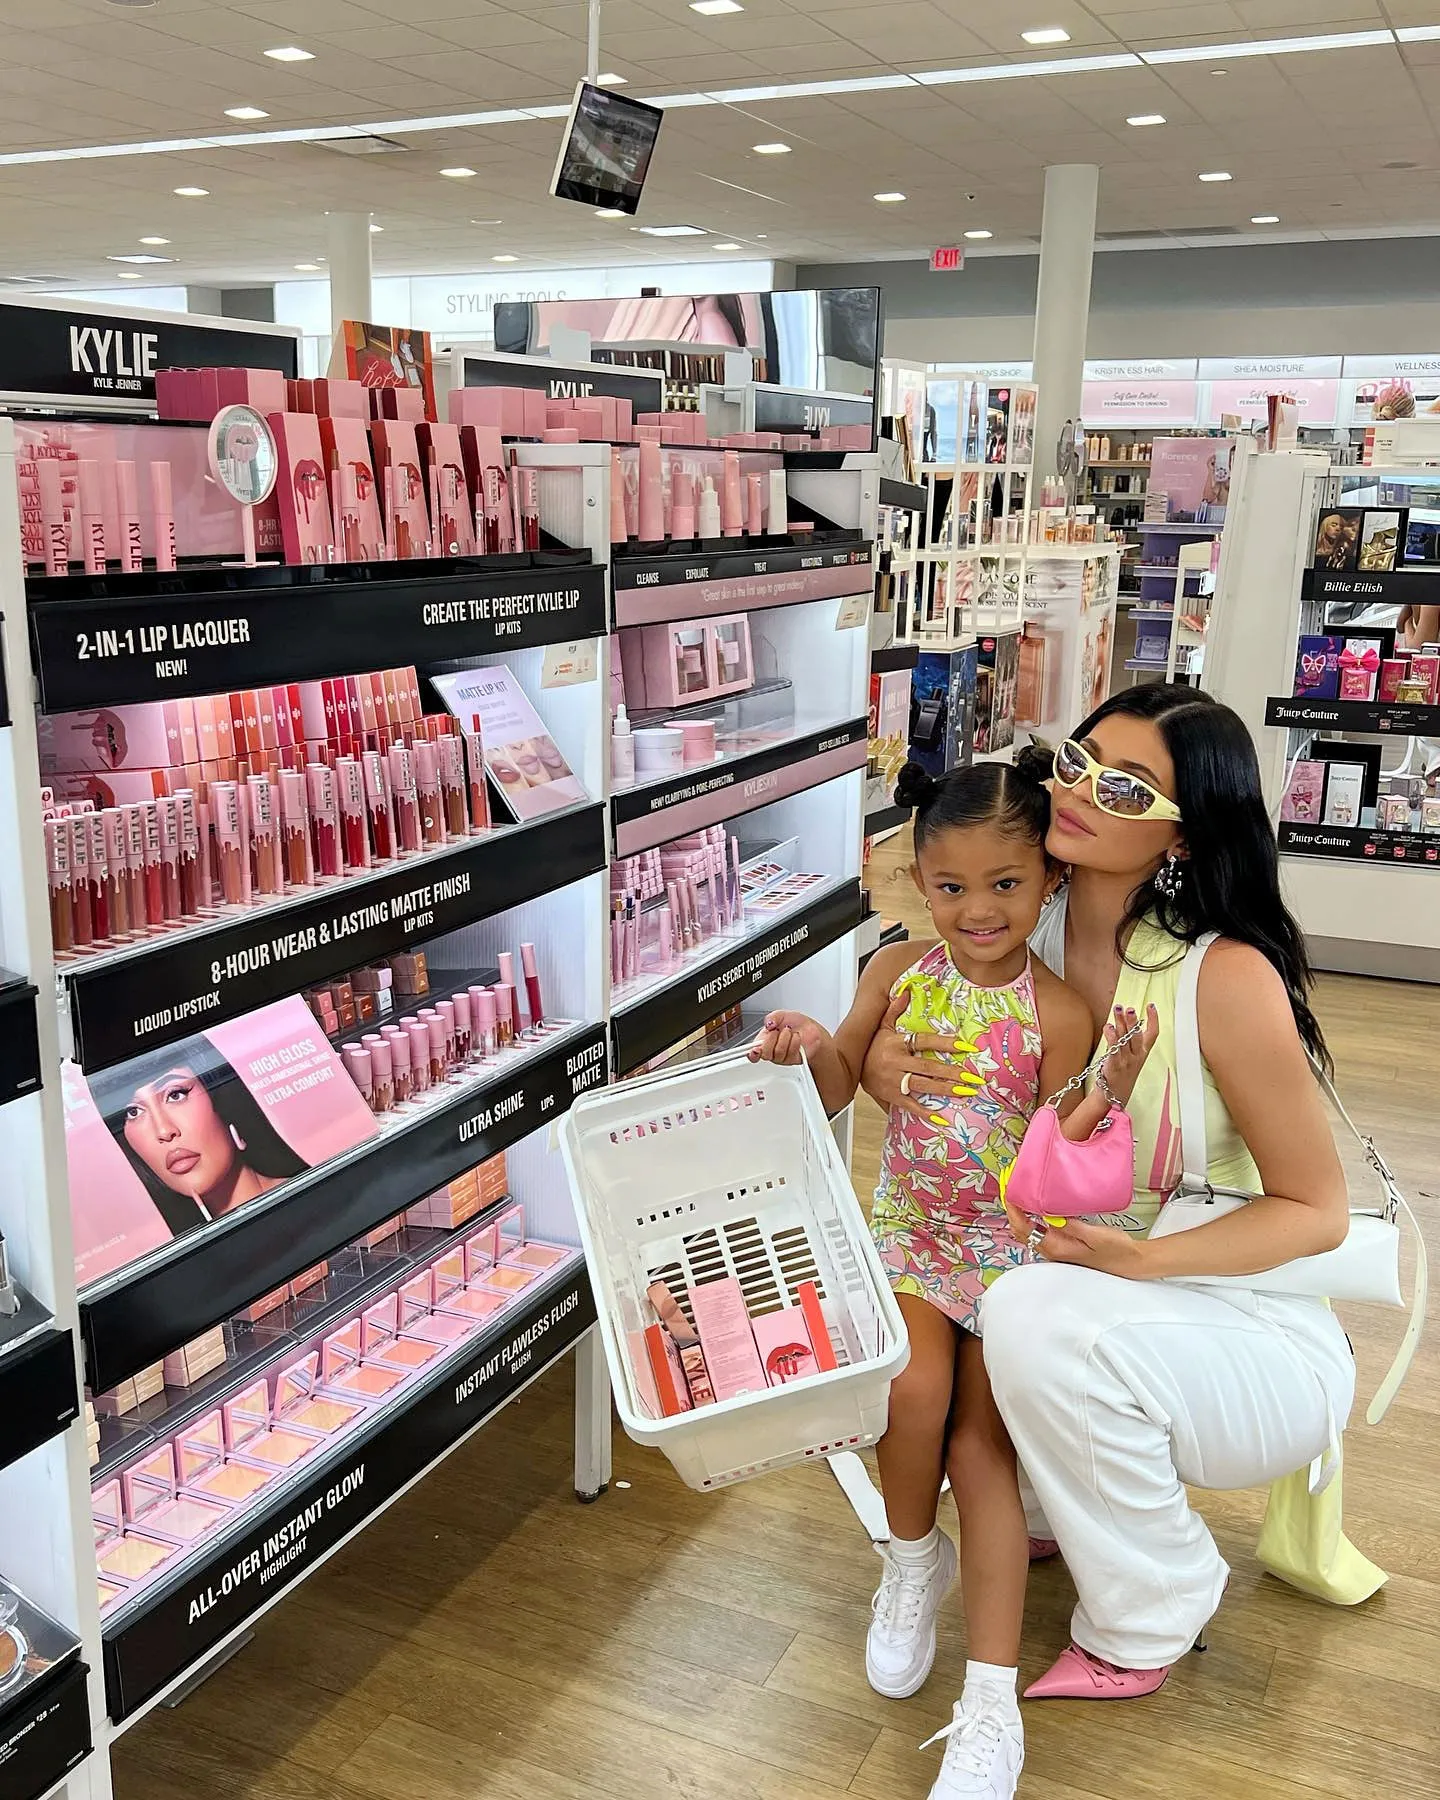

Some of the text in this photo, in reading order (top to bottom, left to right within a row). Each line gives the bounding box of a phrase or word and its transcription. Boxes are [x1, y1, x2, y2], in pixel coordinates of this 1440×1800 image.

[935, 248, 960, 267] EXIT
[70, 325, 158, 377] KYLIE
[1000, 368, 1022, 377] SHOP
[1095, 365, 1164, 375] KRISTIN ESS HAIR
[1233, 364, 1305, 373] SHEA MOISTURE
[1395, 361, 1440, 370] WELLNESS
[93, 377, 142, 390] KYLIE JENNER
[51, 524, 67, 572] KYLIE
[92, 523, 106, 571] KYLIE
[128, 522, 142, 568] KYLIE
[685, 567, 709, 580] EXFOLIATE
[754, 561, 767, 573] TREAT
[832, 555, 848, 565] PROTECT
[637, 571, 660, 585] CLEANSE
[1324, 581, 1383, 594] Billie Eilish
[423, 589, 580, 625] CREATE THE PERFECT KYLIE LIP
[76, 618, 250, 660] 2-IN-1 LIP LACQUER
[495, 620, 522, 636] LIP KITS
[155, 659, 188, 678] NEW!
[456, 681, 508, 701] MATTE LIP KIT
[1275, 706, 1339, 720] Juicy Couture
[650, 797, 664, 810] NEW!
[664, 787, 692, 805] CLARIFYING
[696, 772, 734, 795] PORE-PERFECTING
[1288, 831, 1351, 847] Juicy Couture
[210, 872, 471, 984] 8-HOUR WEAR & LASTING MATTE FINISH
[403, 910, 434, 934] LIP KITS
[697, 924, 809, 1004] KYLIE'S SECRET TO DEFINED EYE LOOKS
[133, 990, 221, 1036] LIQUID LIPSTICK
[249, 1038, 317, 1077] HIGH GLOSS
[566, 1041, 604, 1076] BLOTTED
[263, 1066, 335, 1106] ULTRA COMFORT
[572, 1065, 602, 1095] MATTE
[459, 1090, 525, 1143] ULTRA SHINE
[540, 1095, 555, 1112] LIPS
[455, 1290, 579, 1404] INSTANT FLAWLESS FLUSH
[511, 1349, 532, 1375] BLUSH
[682, 1352, 712, 1402] KYLIE
[188, 1549, 261, 1625] ALL-OVER
[263, 1496, 324, 1562] INSTANT
[326, 1463, 365, 1511] GLOW
[259, 1536, 308, 1586] HIGHLIGHT
